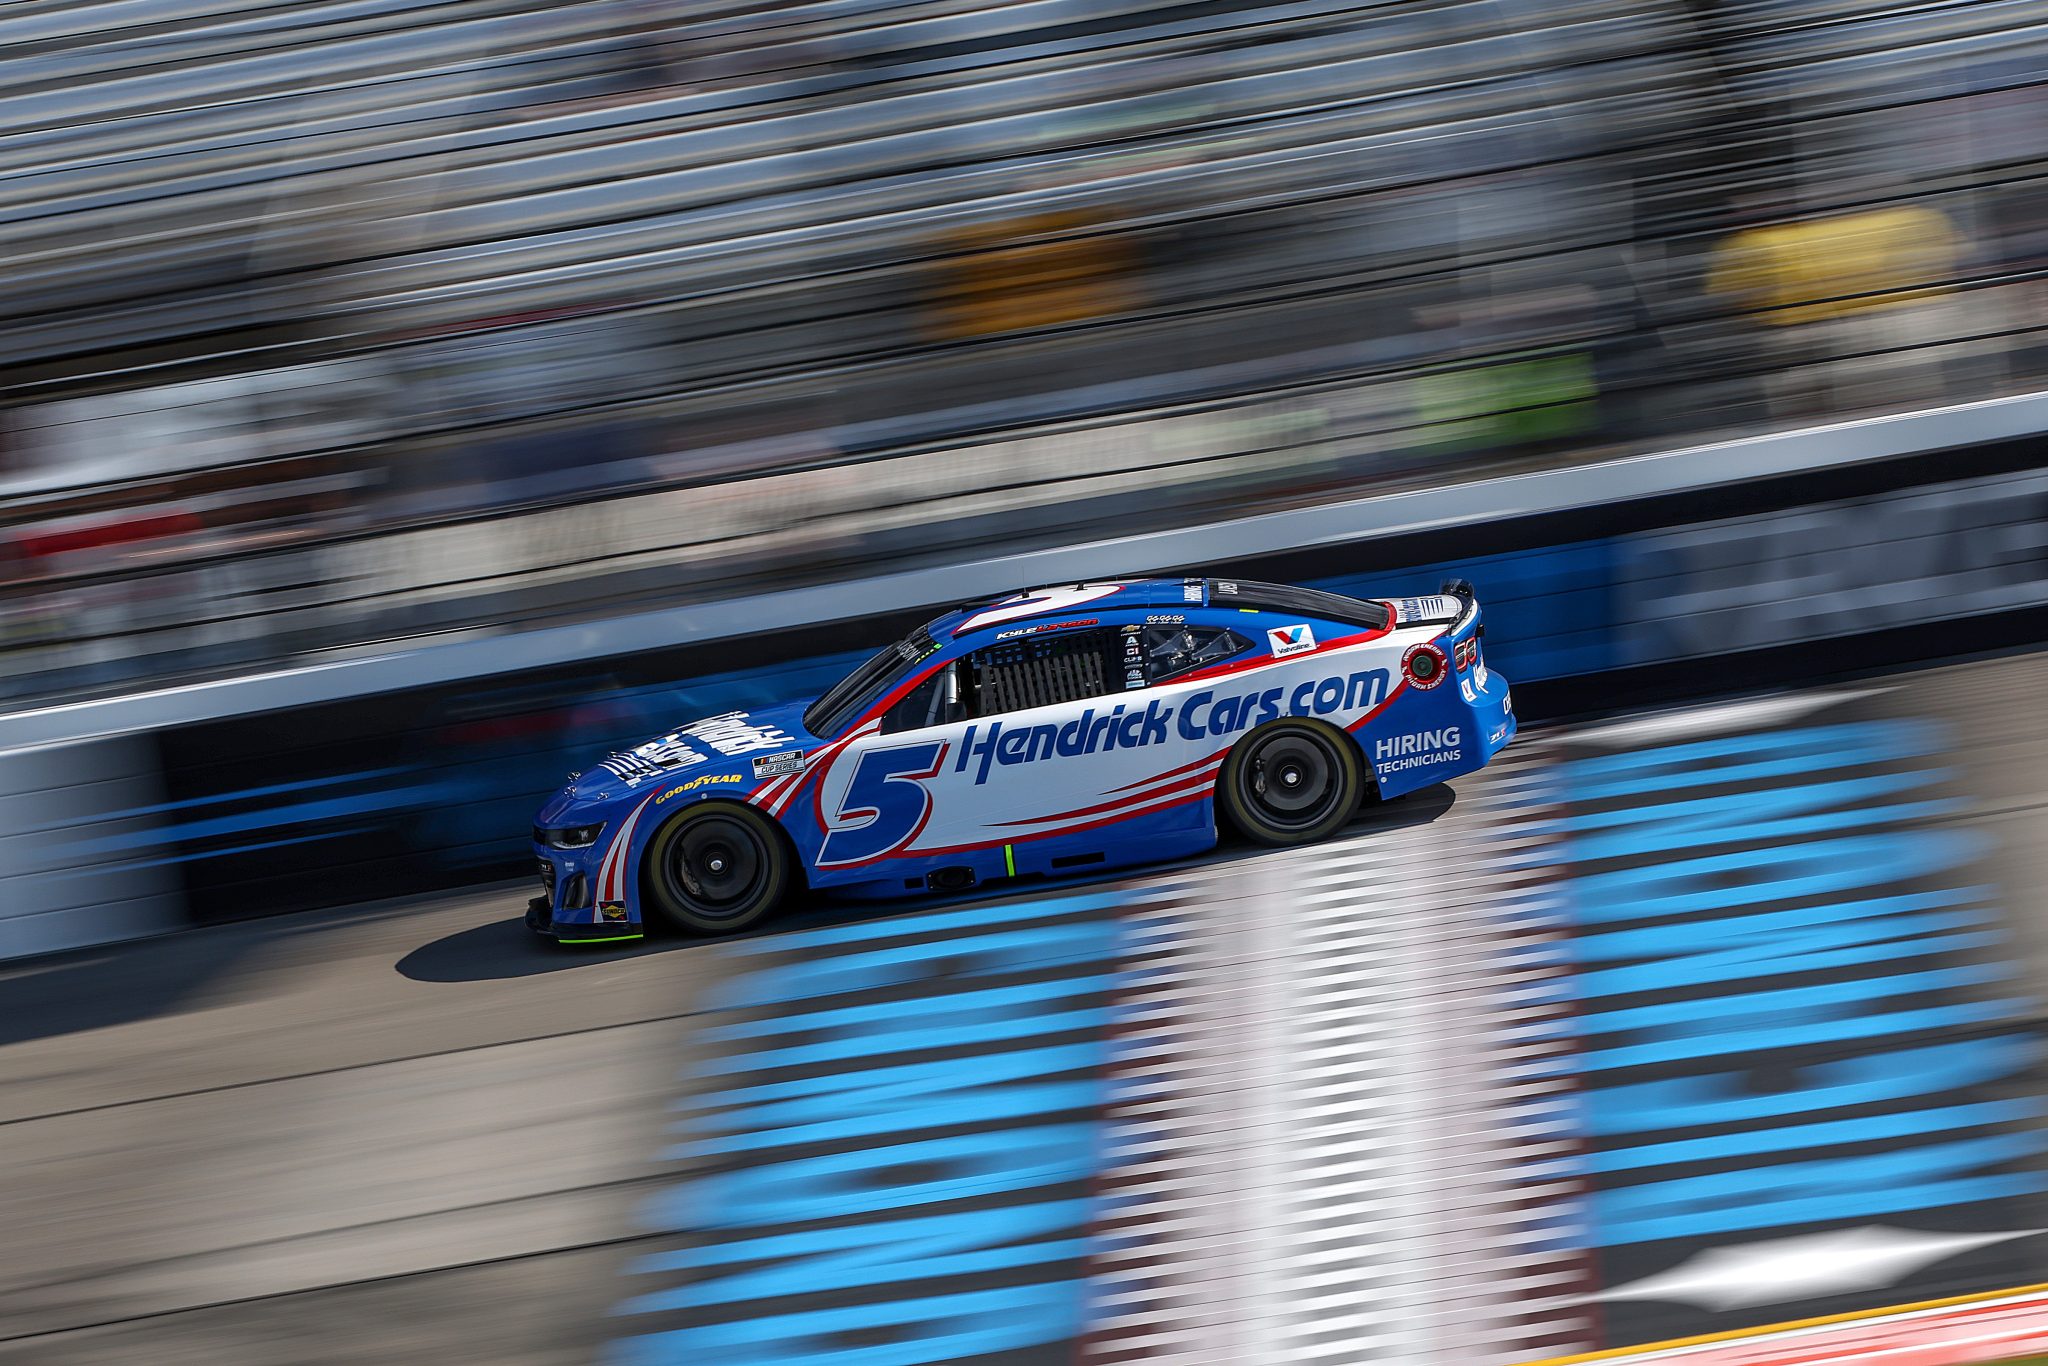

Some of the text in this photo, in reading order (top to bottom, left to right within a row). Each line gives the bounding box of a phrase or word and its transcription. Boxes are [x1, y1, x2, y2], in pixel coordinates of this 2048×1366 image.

[955, 699, 1174, 786] Hendrick
[1177, 667, 1390, 741] Carscom
[768, 752, 796, 764] NASCAR
[1376, 726, 1461, 760] HIRING
[774, 761, 798, 772] SERIES
[1376, 750, 1461, 774] TECHNICIANS
[655, 773, 743, 805] GOODYEAR
[815, 738, 950, 869] 5
